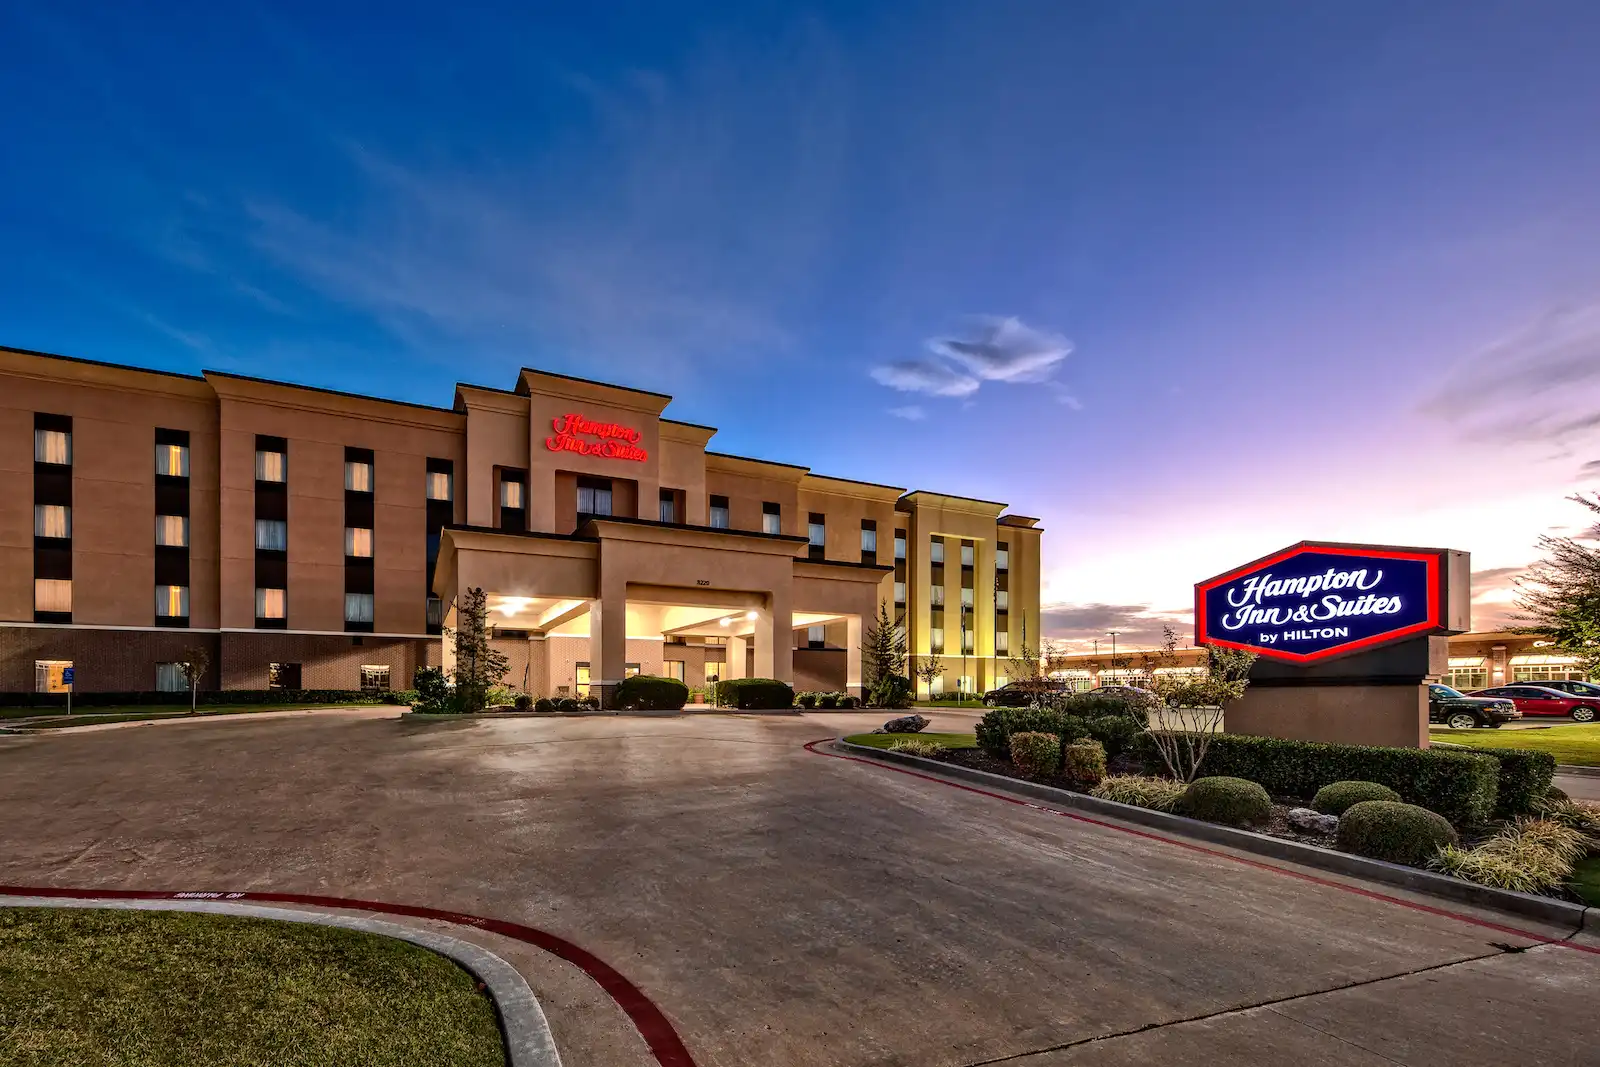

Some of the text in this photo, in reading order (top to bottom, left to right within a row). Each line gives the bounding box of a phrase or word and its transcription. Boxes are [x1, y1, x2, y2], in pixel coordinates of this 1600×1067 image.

[552, 413, 642, 443] Hampton
[546, 434, 592, 455] Inn
[602, 440, 648, 462] Suites
[1227, 568, 1382, 607] Hampton
[1222, 595, 1401, 630] Inn & Suites
[1260, 627, 1348, 643] by HILTON
